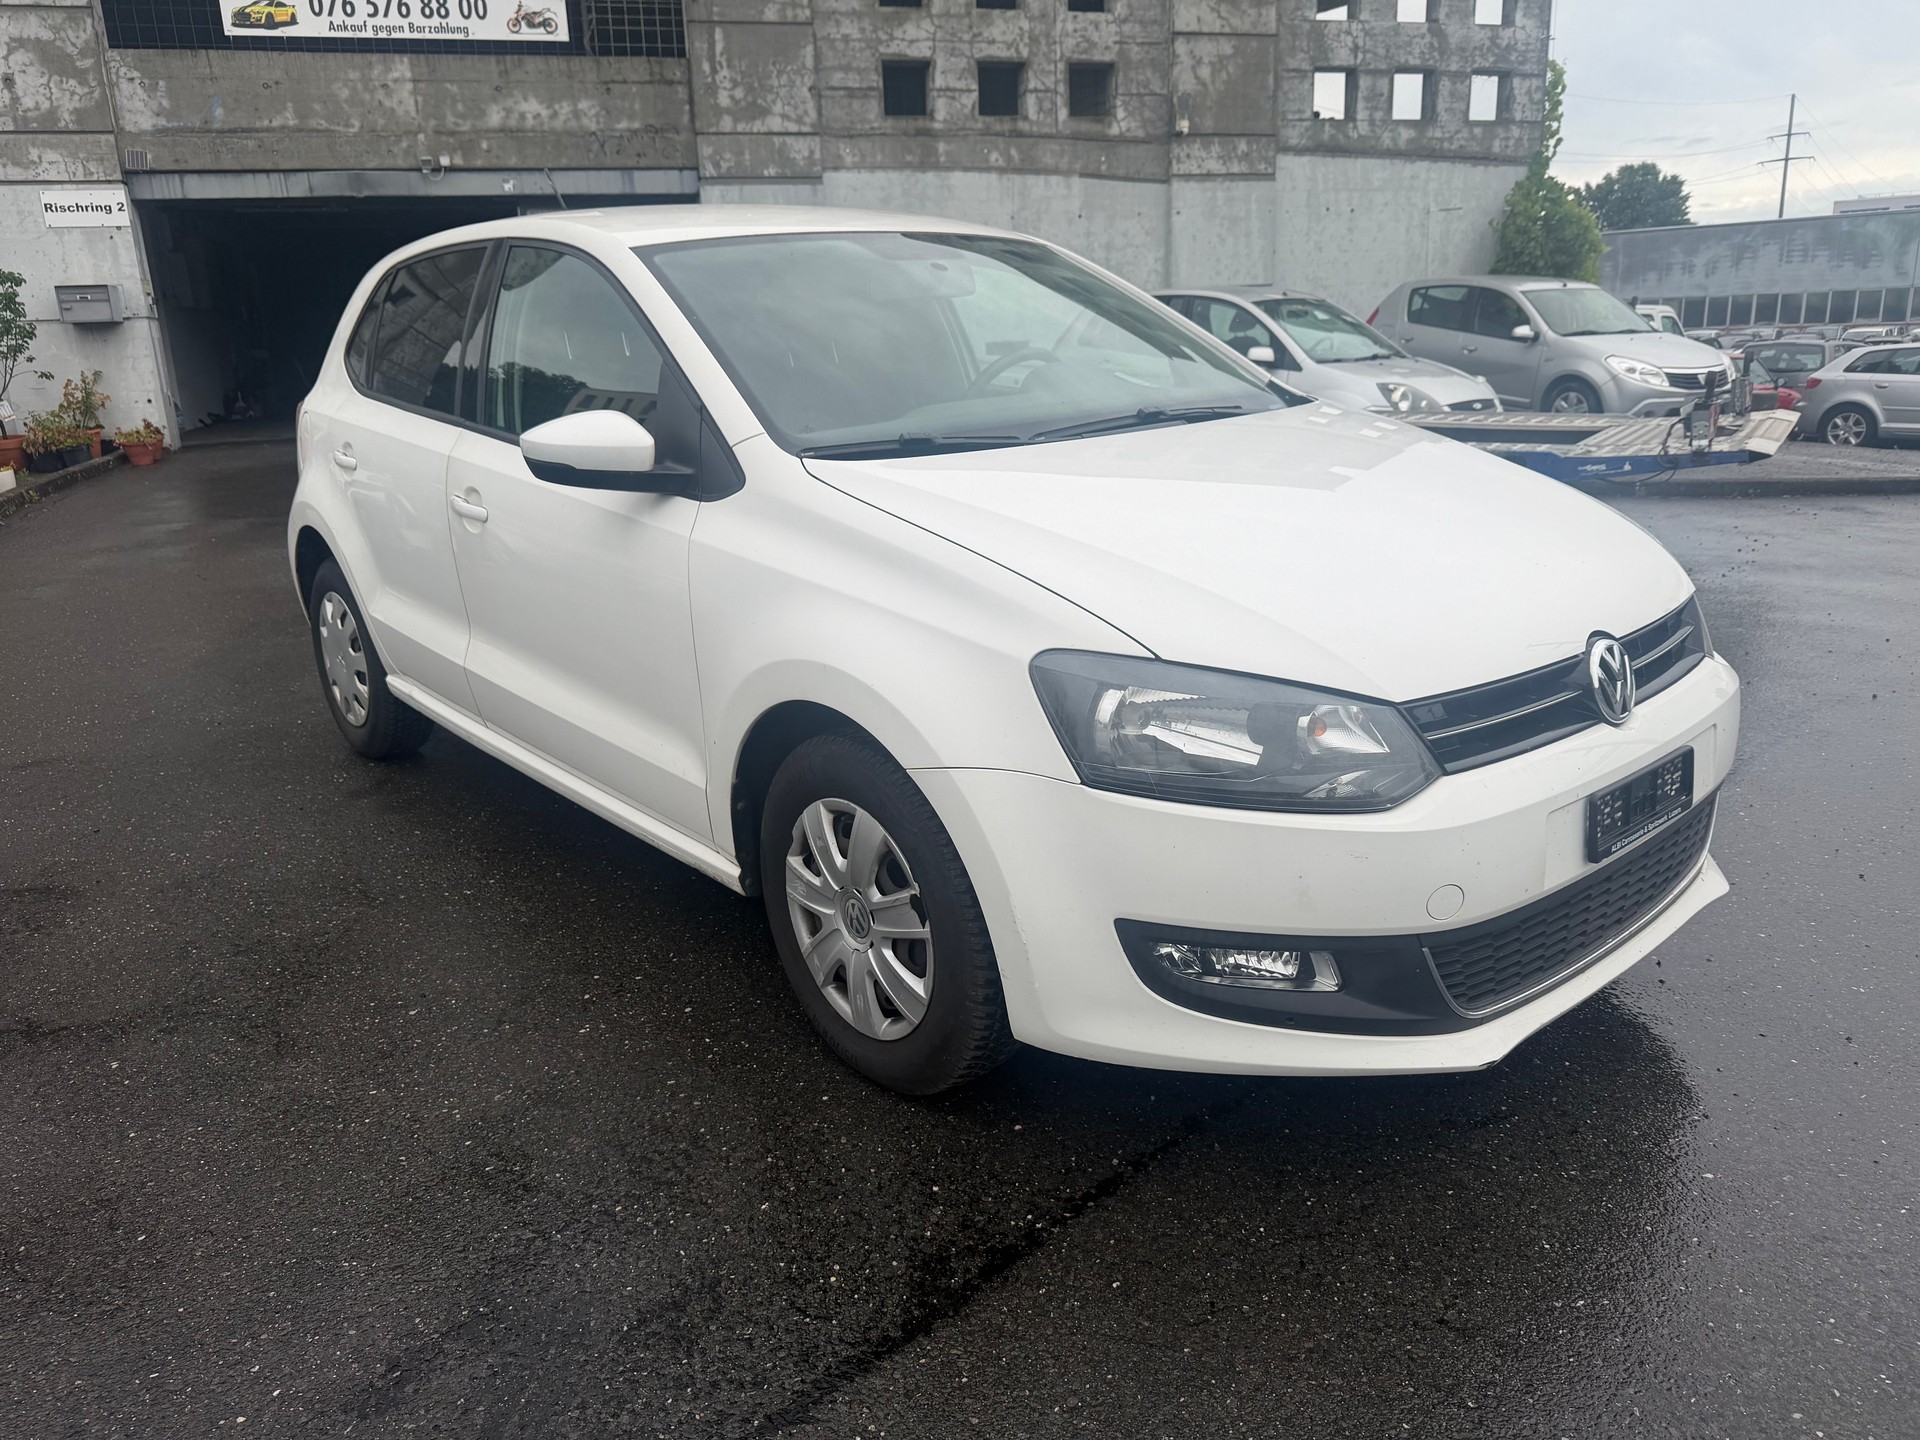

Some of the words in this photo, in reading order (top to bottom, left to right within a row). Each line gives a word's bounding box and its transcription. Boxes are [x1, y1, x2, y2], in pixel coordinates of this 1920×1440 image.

[309, 0, 356, 18] 076
[366, 0, 411, 19] 576
[420, 0, 450, 19] 88
[458, 0, 488, 20] 00
[328, 20, 367, 33] Ankauf
[371, 25, 405, 36] gegen
[408, 22, 470, 38] Barzahlung
[43, 202, 113, 215] Rischring
[116, 202, 126, 212] 2
